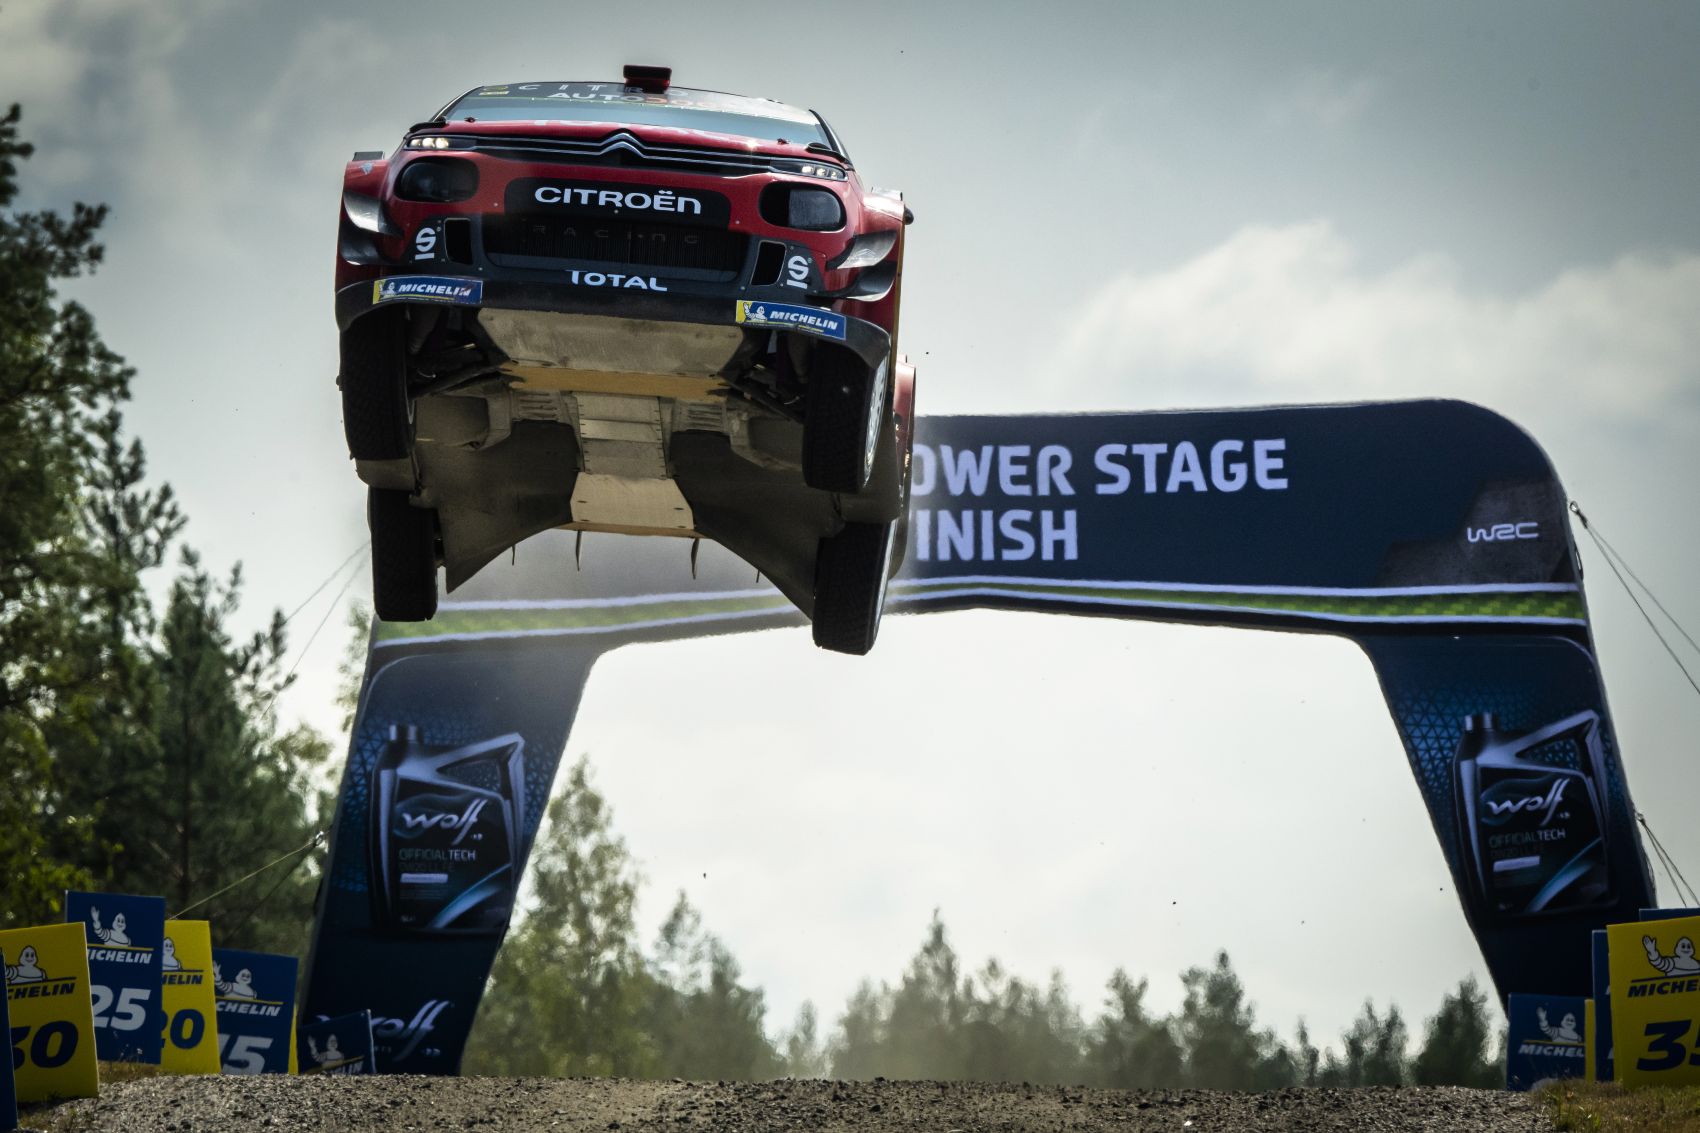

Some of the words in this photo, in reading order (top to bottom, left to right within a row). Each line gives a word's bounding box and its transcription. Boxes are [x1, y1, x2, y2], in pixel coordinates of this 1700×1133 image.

[398, 283, 472, 297] MICHELIN
[565, 269, 668, 292] TOTAL
[769, 310, 838, 330] MICHELIN
[910, 443, 1076, 497] OWER
[1094, 438, 1289, 495] STAGE
[909, 508, 1078, 561] INISH
[1466, 521, 1539, 543] WRC
[88, 949, 152, 965] ICHELIN
[8, 982, 76, 1000] CHELIN
[91, 984, 152, 1032] 25
[216, 1001, 281, 1017] CHELIN
[1518, 1044, 1584, 1059] MICHEL
